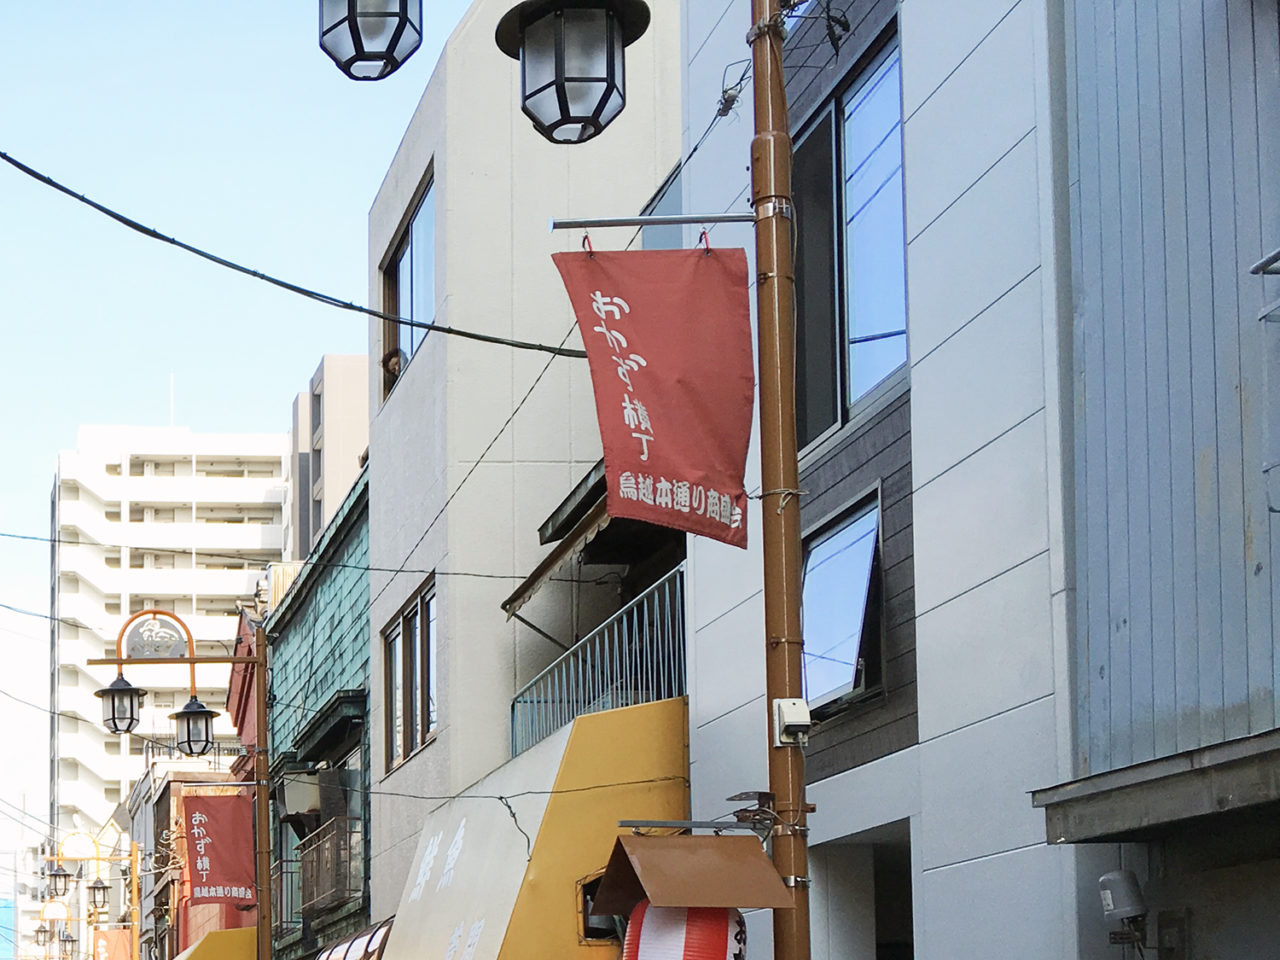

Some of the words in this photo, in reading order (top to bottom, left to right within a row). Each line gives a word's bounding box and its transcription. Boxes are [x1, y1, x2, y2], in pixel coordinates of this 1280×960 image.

[589, 290, 655, 461] おかず横丁
[191, 811, 212, 882] おかず横丁
